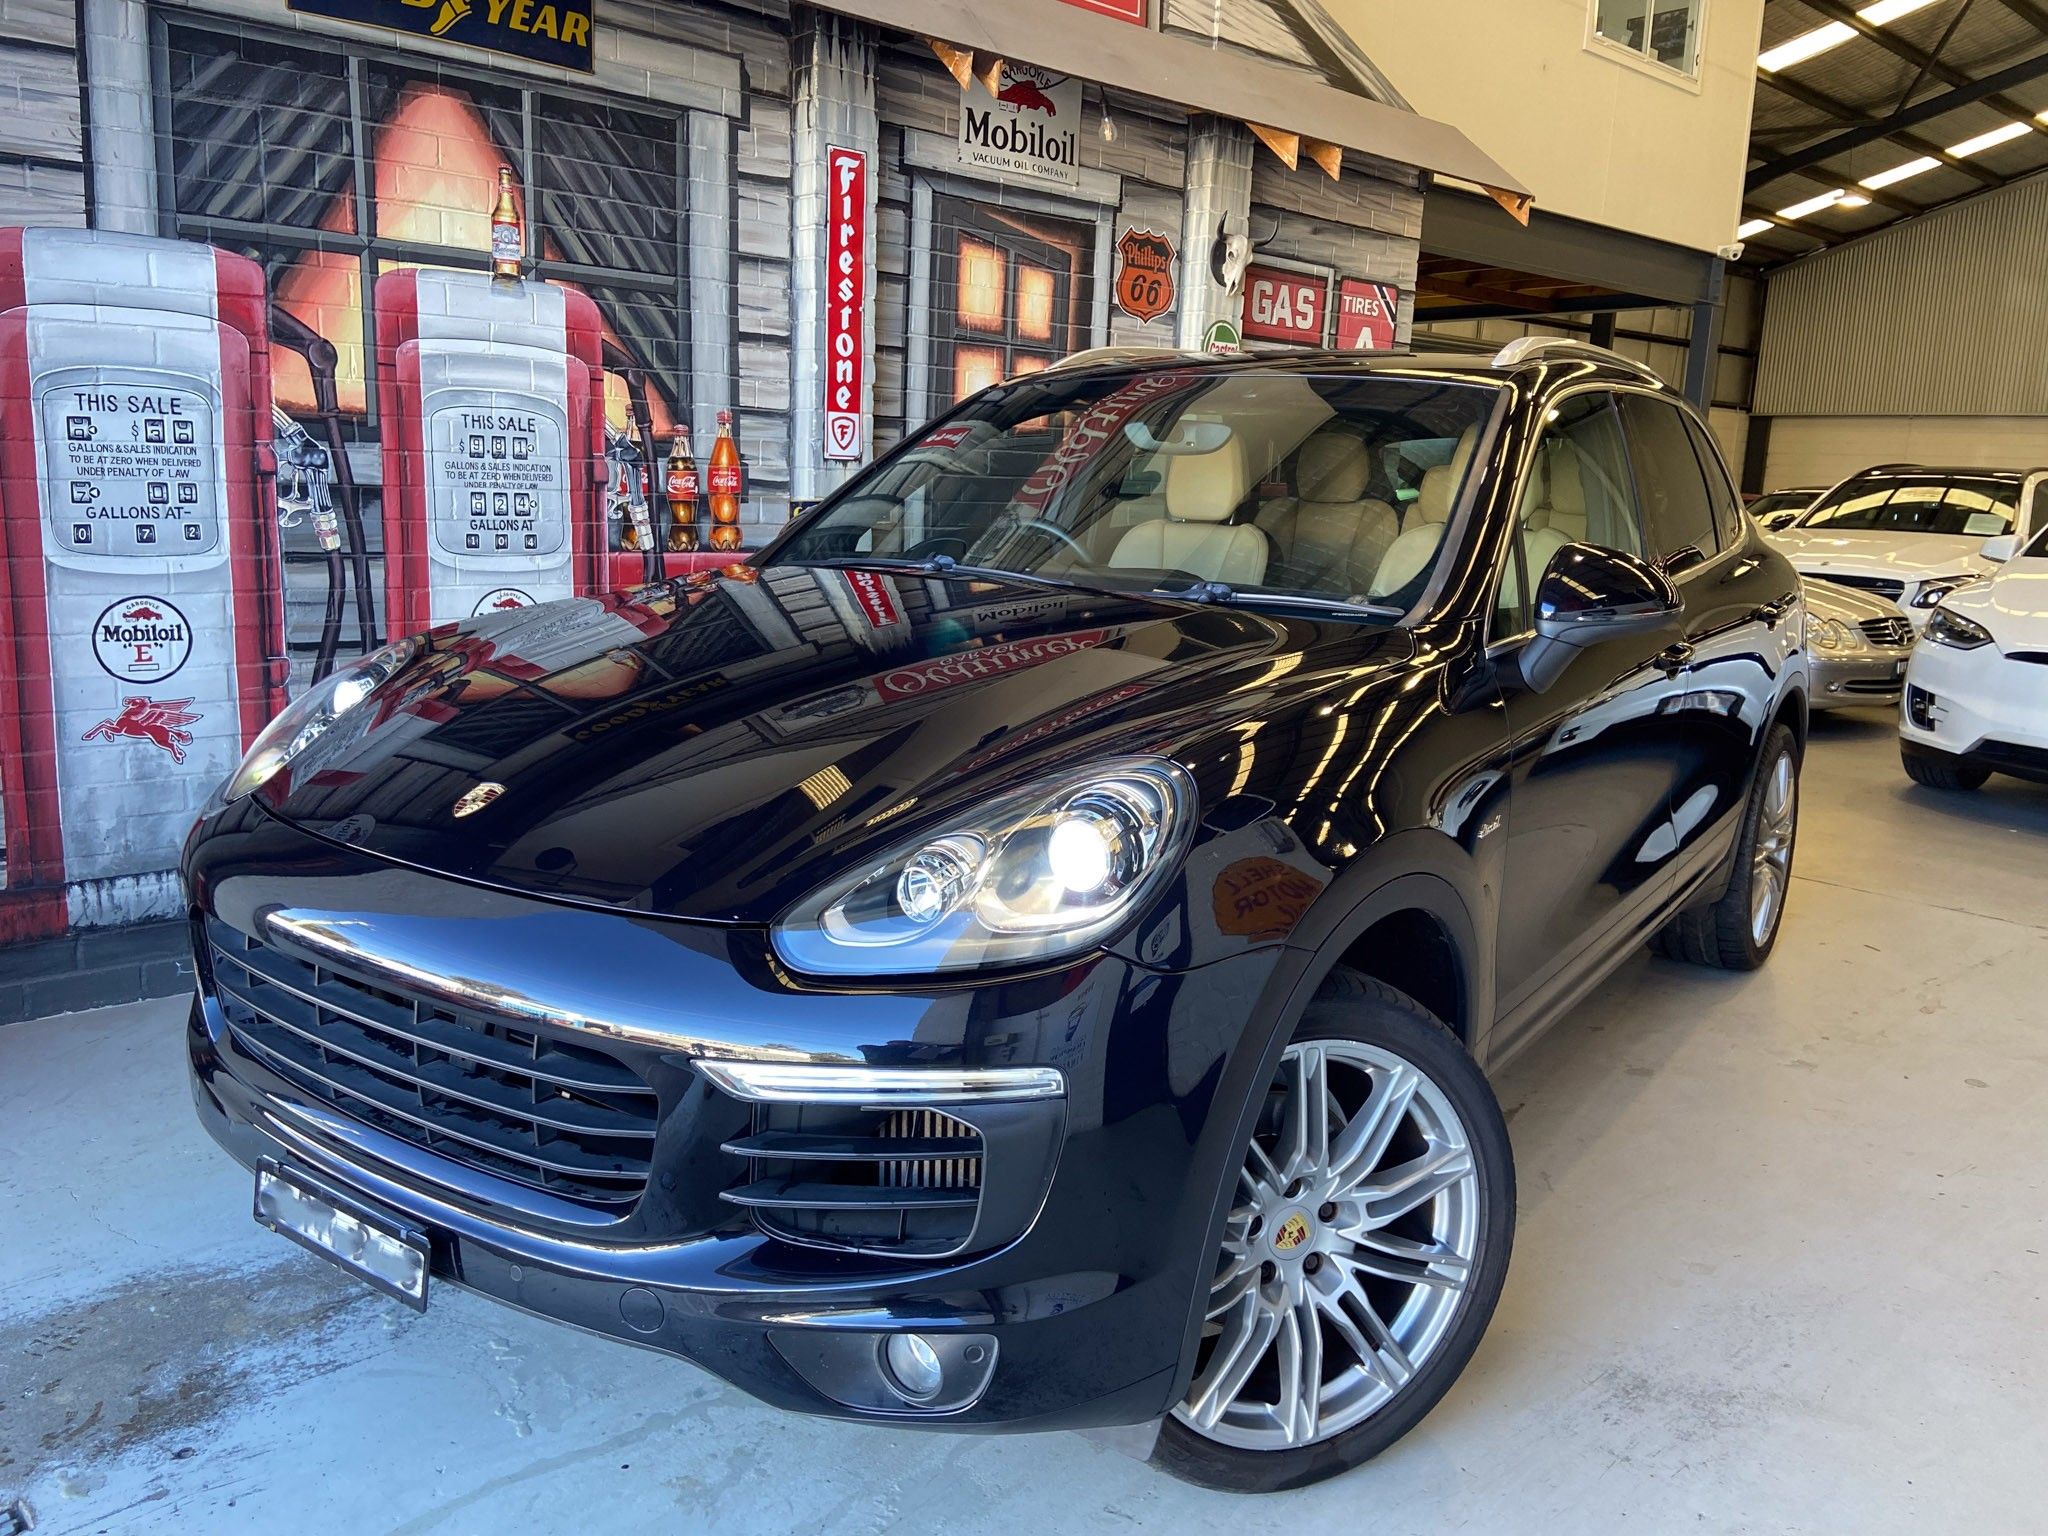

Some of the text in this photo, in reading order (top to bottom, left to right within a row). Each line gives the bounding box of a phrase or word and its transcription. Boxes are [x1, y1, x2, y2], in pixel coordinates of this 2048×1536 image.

[964, 107, 1075, 167] Mobiloil
[972, 152, 1068, 180] VACUUM OIL COMPANY
[1125, 242, 1166, 274] Phillips
[835, 156, 860, 410] Firestone
[1130, 274, 1162, 306] 66
[1251, 280, 1315, 330] GAS
[1343, 295, 1380, 317] TIRES
[74, 393, 182, 415] THIS SALE
[461, 414, 536, 433] THIS SALE
[68, 442, 114, 453] GALLONS
[123, 444, 151, 454] SALES
[153, 445, 197, 455] INDICATION
[69, 455, 201, 467] TO BE AT ZERO WHEN DELIVERED
[445, 461, 479, 470] GALLONS
[488, 463, 510, 471] SALES
[512, 464, 551, 472] INDICATION
[77, 466, 190, 478] UNDER PENALTY OF LAW
[446, 471, 553, 482] TO BE AT ZERO WHEN DELIVERED
[86, 506, 160, 519] GALLONS
[470, 520, 534, 531] GALLONS AT
[102, 624, 184, 642] Mobiloil
